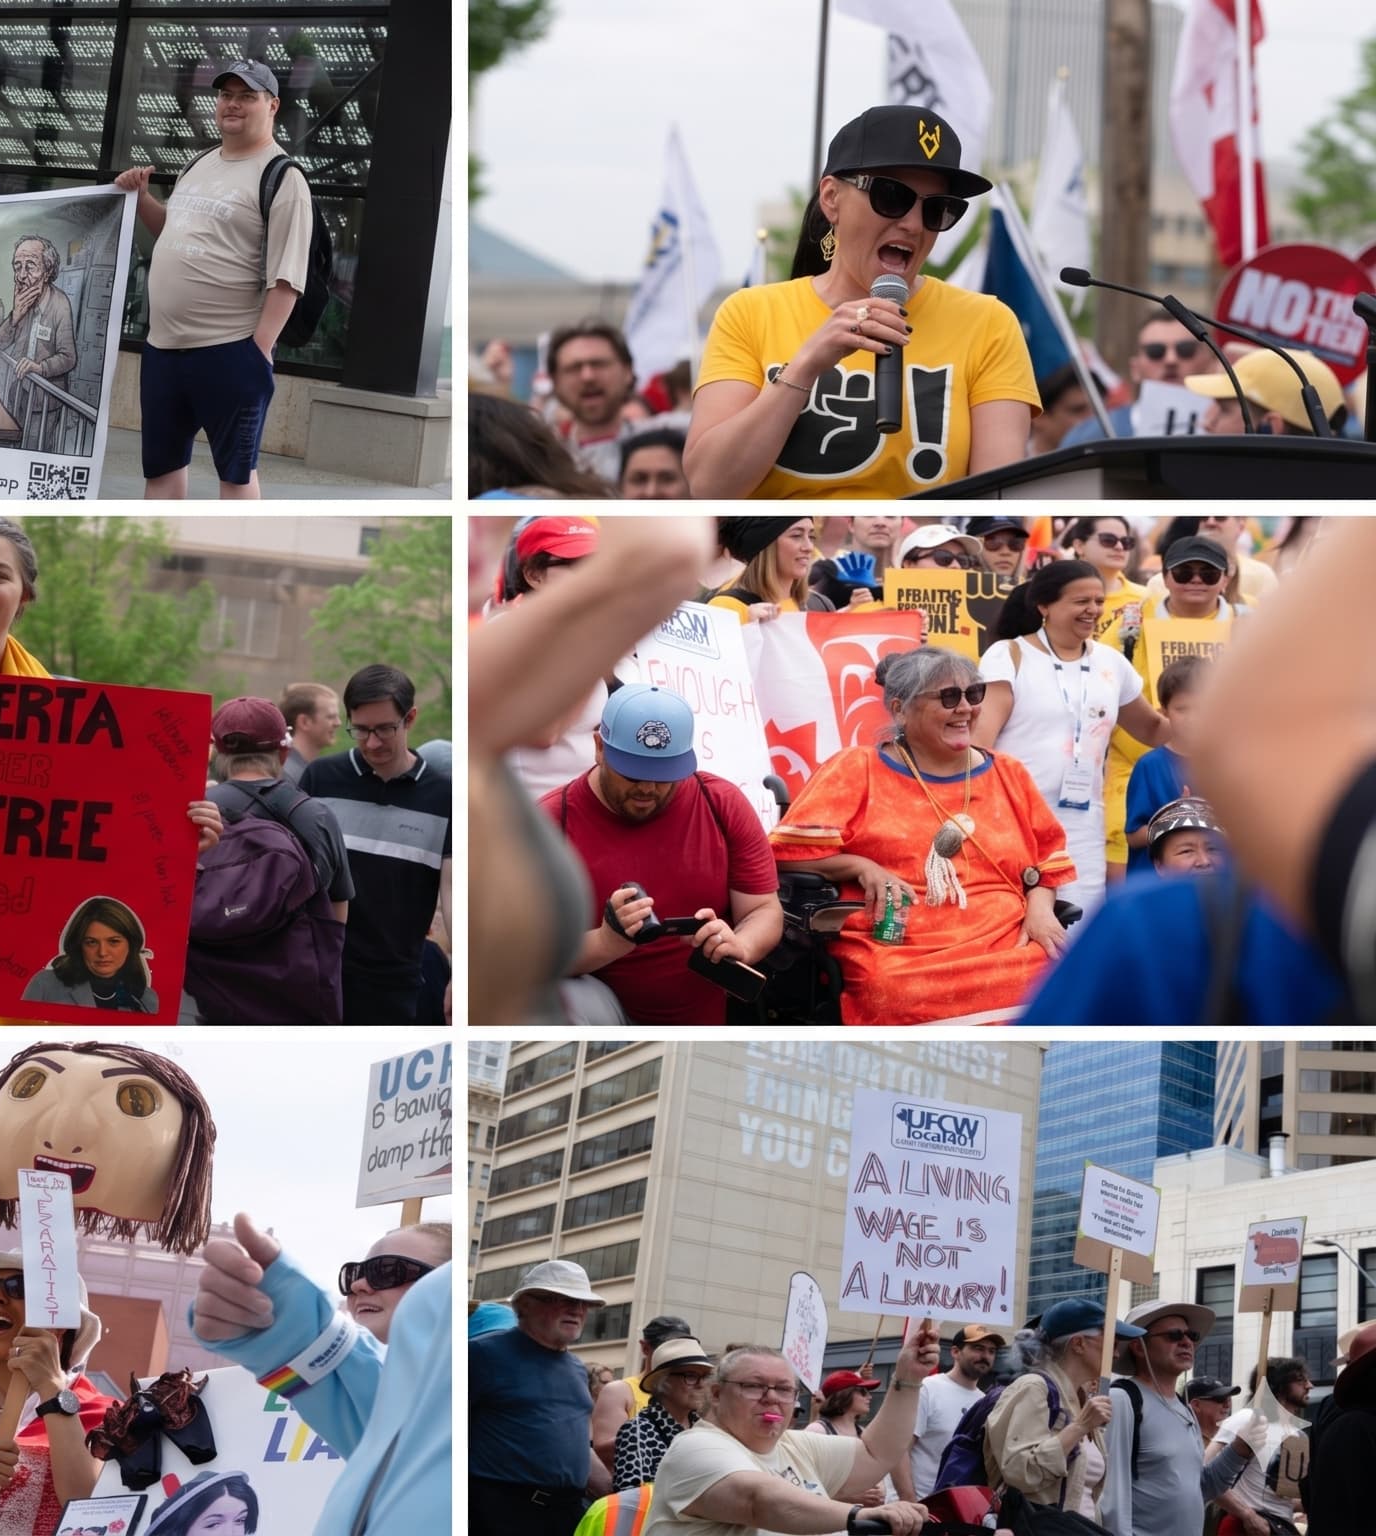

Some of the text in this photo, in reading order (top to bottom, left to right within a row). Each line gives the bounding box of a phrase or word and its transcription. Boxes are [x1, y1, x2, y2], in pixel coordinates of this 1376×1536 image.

[1228, 267, 1312, 337] NO
[737, 1111, 813, 1169] YOU
[906, 1108, 980, 1140] UFCW
[854, 1152, 1011, 1205] A LIVING
[854, 1206, 987, 1243] WAGE IS
[896, 1241, 972, 1270] NOT
[842, 1260, 869, 1299] A
